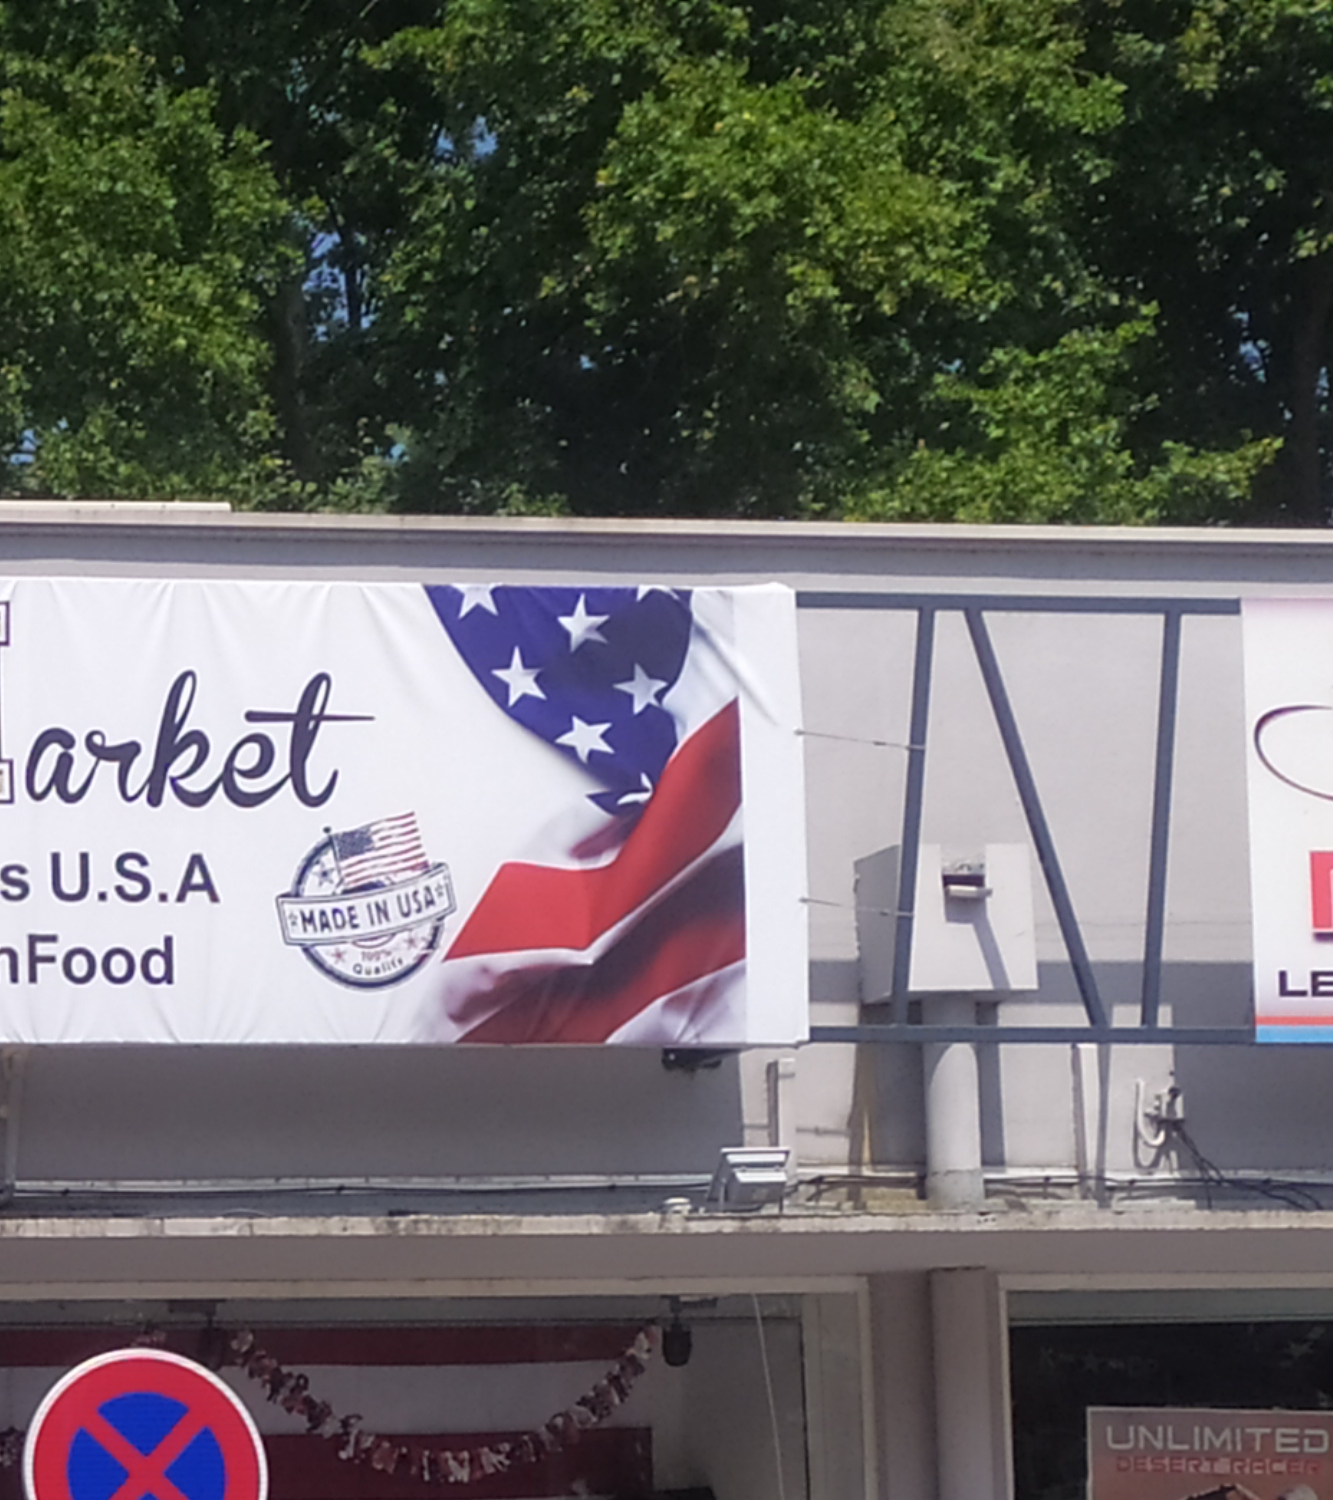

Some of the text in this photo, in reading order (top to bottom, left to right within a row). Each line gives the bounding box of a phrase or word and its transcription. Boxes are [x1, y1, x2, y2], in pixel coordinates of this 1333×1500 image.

[50, 852, 220, 904] U.S.A
[299, 886, 435, 934] MADE IN USA
[1106, 1425, 1330, 1454] UNLIMITED
[1116, 1456, 1322, 1477] DESERT RACER
